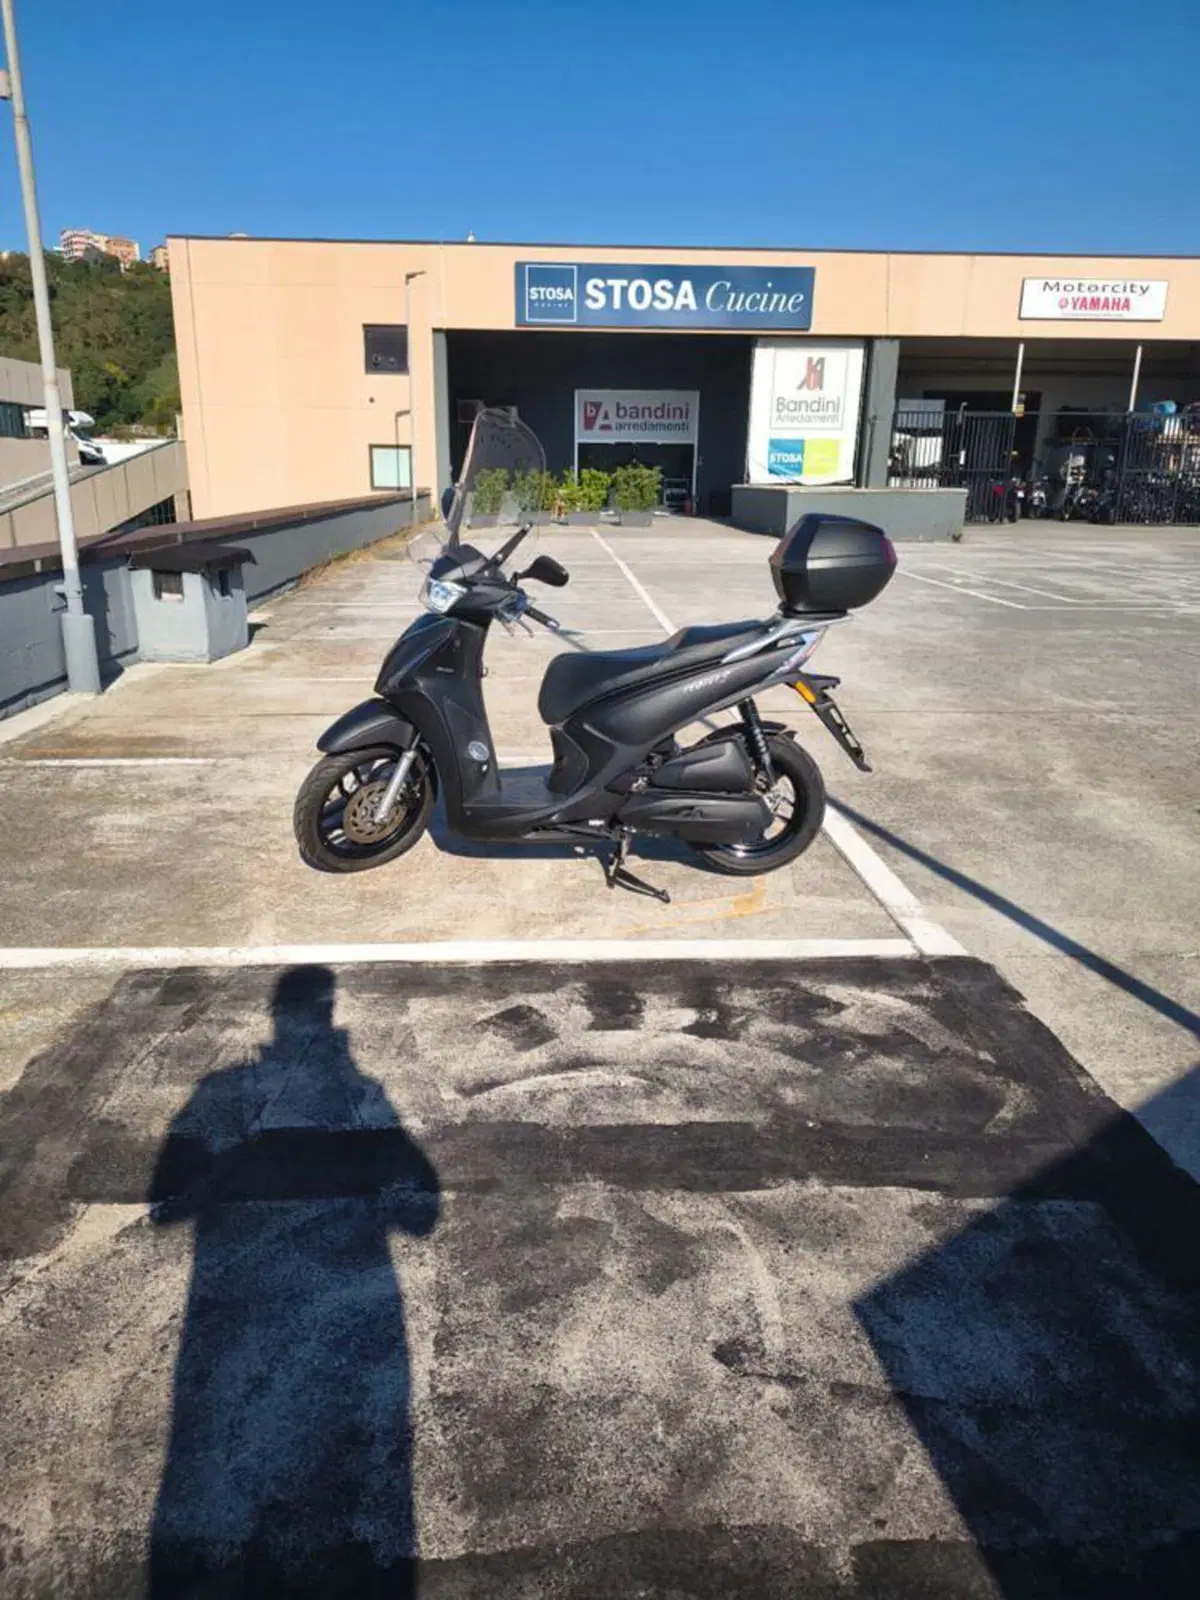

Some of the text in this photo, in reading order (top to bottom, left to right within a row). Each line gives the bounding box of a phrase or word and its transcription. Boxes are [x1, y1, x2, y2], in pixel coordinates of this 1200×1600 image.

[529, 287, 574, 301] STOSA
[585, 278, 804, 313] STOSA Cucine
[1042, 281, 1151, 297] Motorcity
[1071, 297, 1131, 311] YAMAHA
[615, 401, 690, 420] bandini
[775, 396, 841, 413] Bandini
